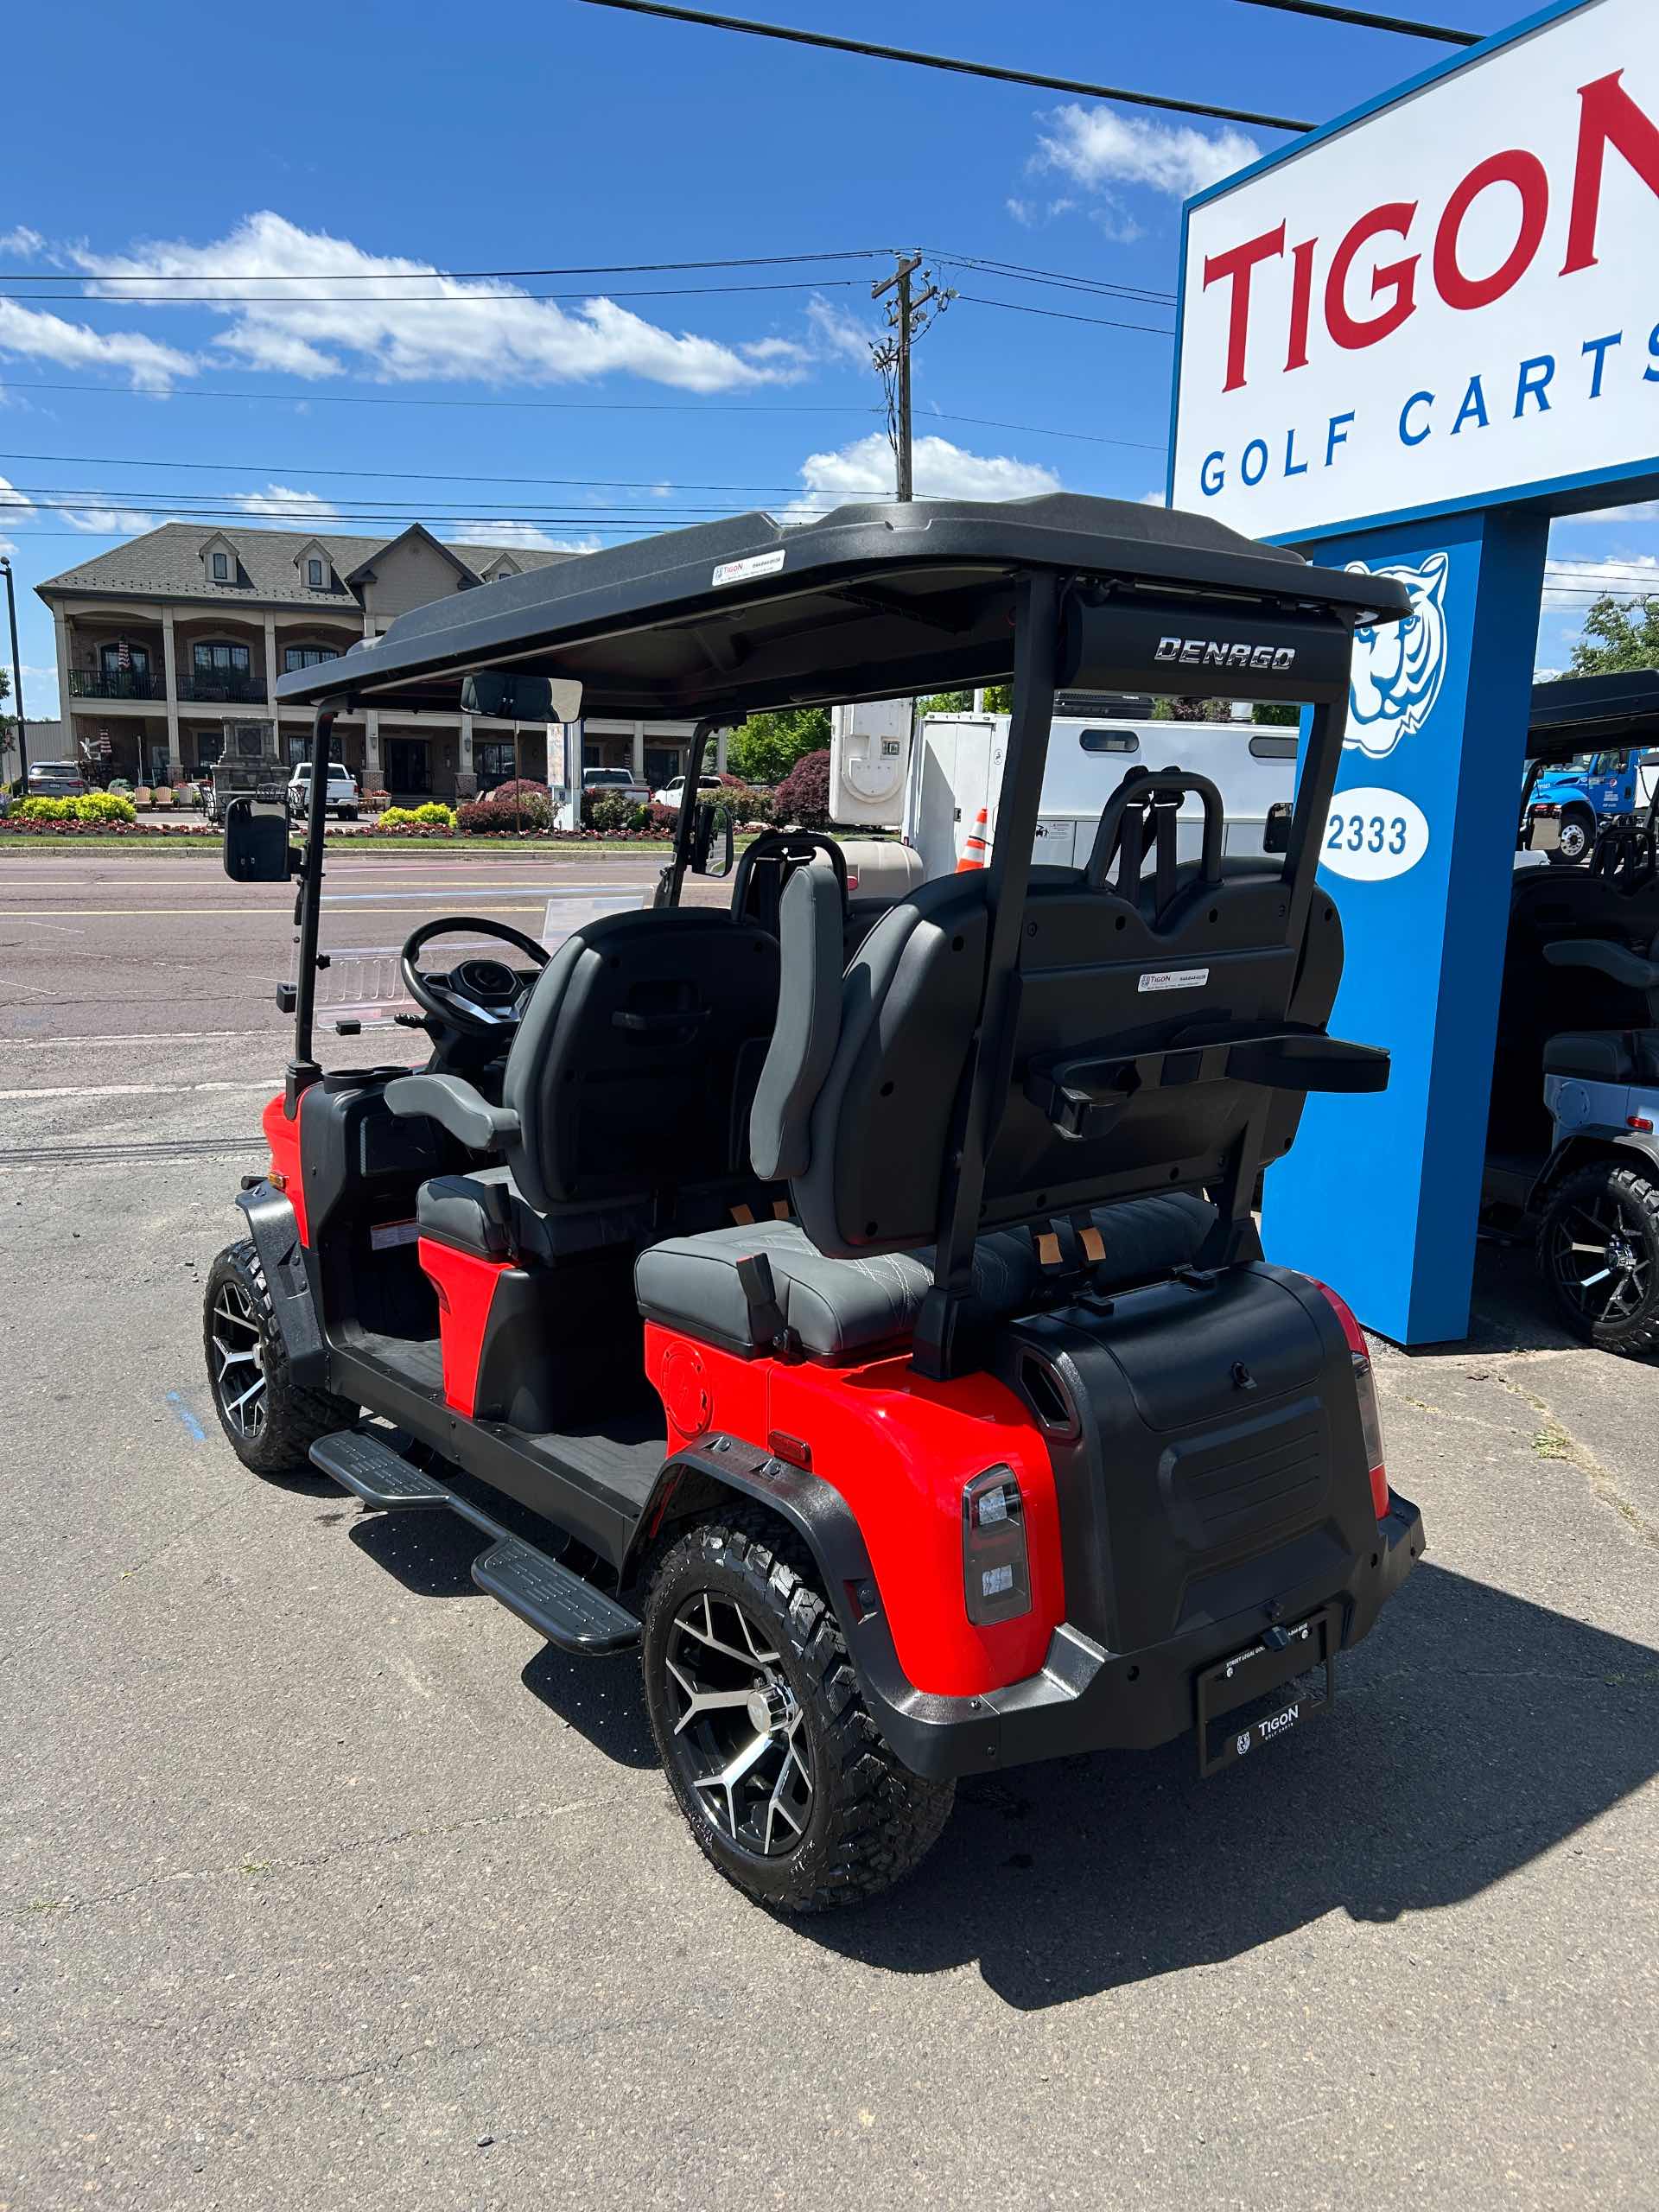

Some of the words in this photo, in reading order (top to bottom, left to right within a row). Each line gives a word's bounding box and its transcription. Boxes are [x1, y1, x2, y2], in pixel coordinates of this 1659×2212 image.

[1203, 67, 1659, 393] TIGON
[1200, 410, 1355, 497] GOLF
[1154, 637, 1296, 671] DENAGO
[1326, 814, 1408, 855] 2333
[1151, 975, 1172, 983] TIGON
[1258, 1704, 1299, 1737] TIGON
